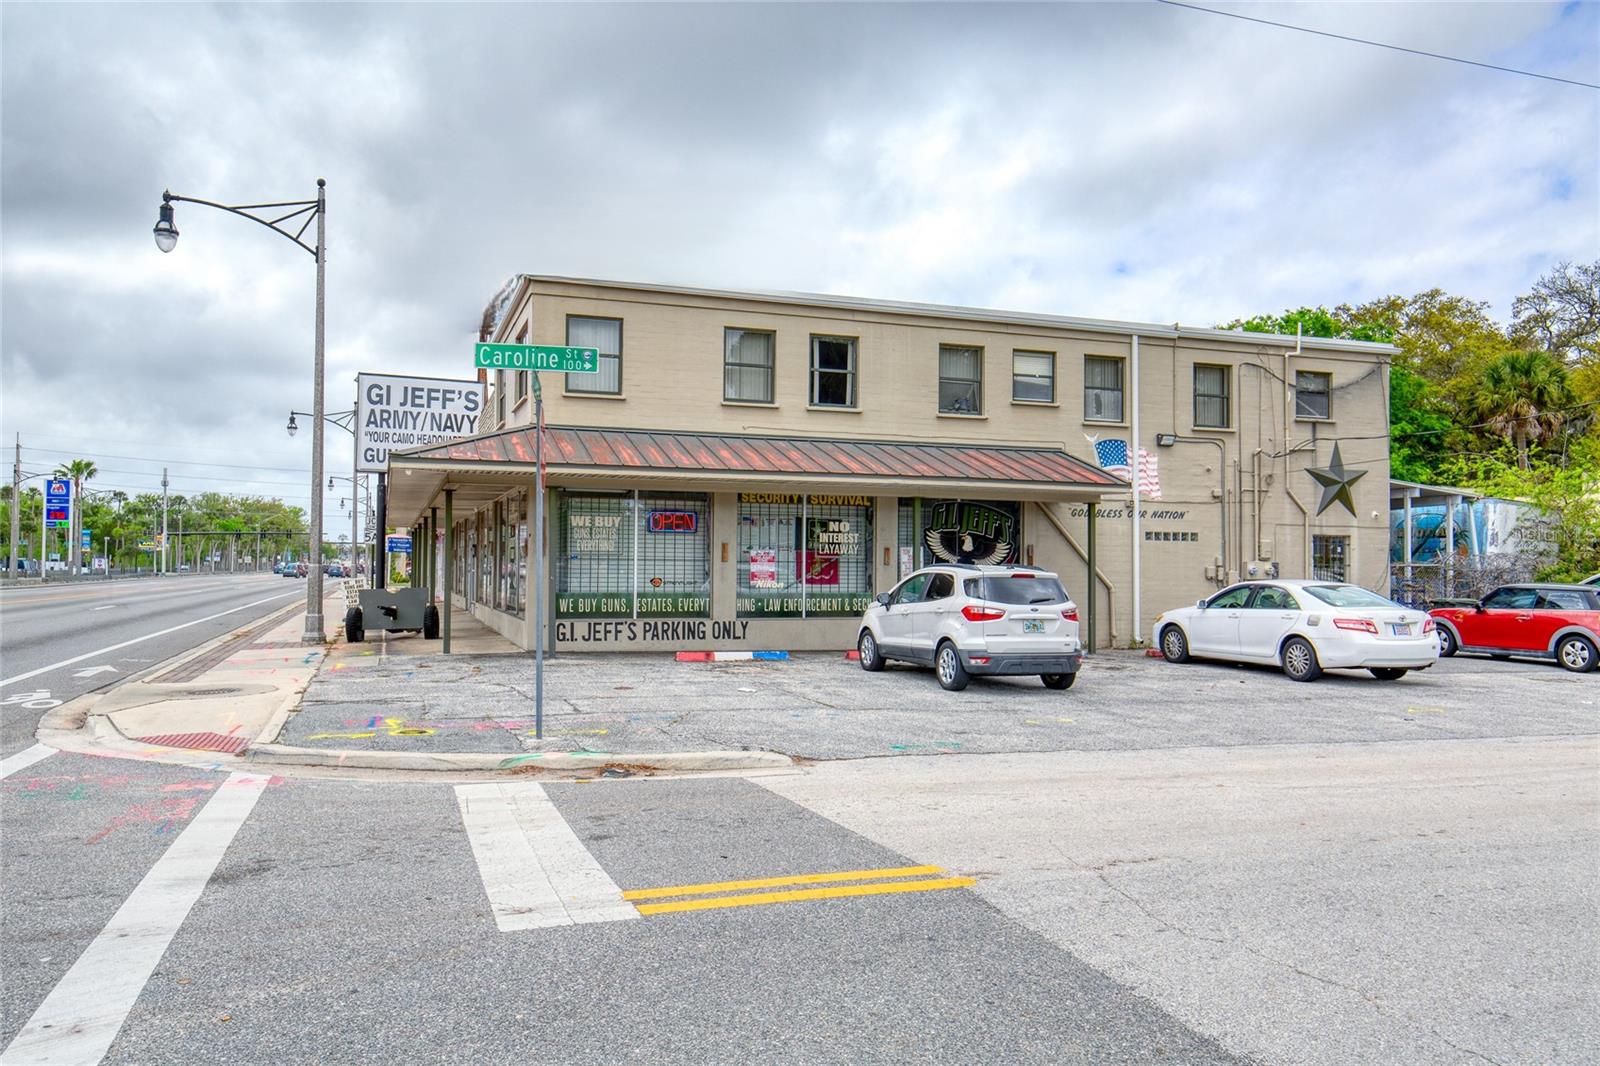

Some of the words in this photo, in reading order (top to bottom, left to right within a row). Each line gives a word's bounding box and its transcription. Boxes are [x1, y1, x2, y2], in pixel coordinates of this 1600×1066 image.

[480, 346, 558, 368] Caroline
[566, 348, 578, 359] St
[563, 360, 582, 370] 100
[366, 383, 391, 406] GI
[400, 386, 479, 412] JEFF'S
[366, 408, 478, 434] ARMY/NAVY
[392, 433, 414, 444] CAMO
[741, 492, 799, 504] SECURITY
[811, 495, 871, 506] SURVIVAL
[1096, 508, 1123, 519] BLESS
[1127, 509, 1147, 519] OR
[570, 515, 592, 527] WE
[594, 516, 622, 528] BUY
[652, 513, 695, 530] OPEN
[828, 521, 850, 532] NO
[819, 532, 859, 544] INTEREST
[819, 543, 859, 555] LAYAWAY
[755, 579, 784, 589] Nikon
[560, 599, 574, 613] WE
[579, 598, 597, 613] BUY
[764, 599, 780, 612] LAW
[845, 598, 850, 611] &
[556, 623, 578, 642] G.I.
[582, 621, 637, 641] JEFF'S
[643, 621, 706, 641] PARKING
[712, 621, 749, 640] ONLY
